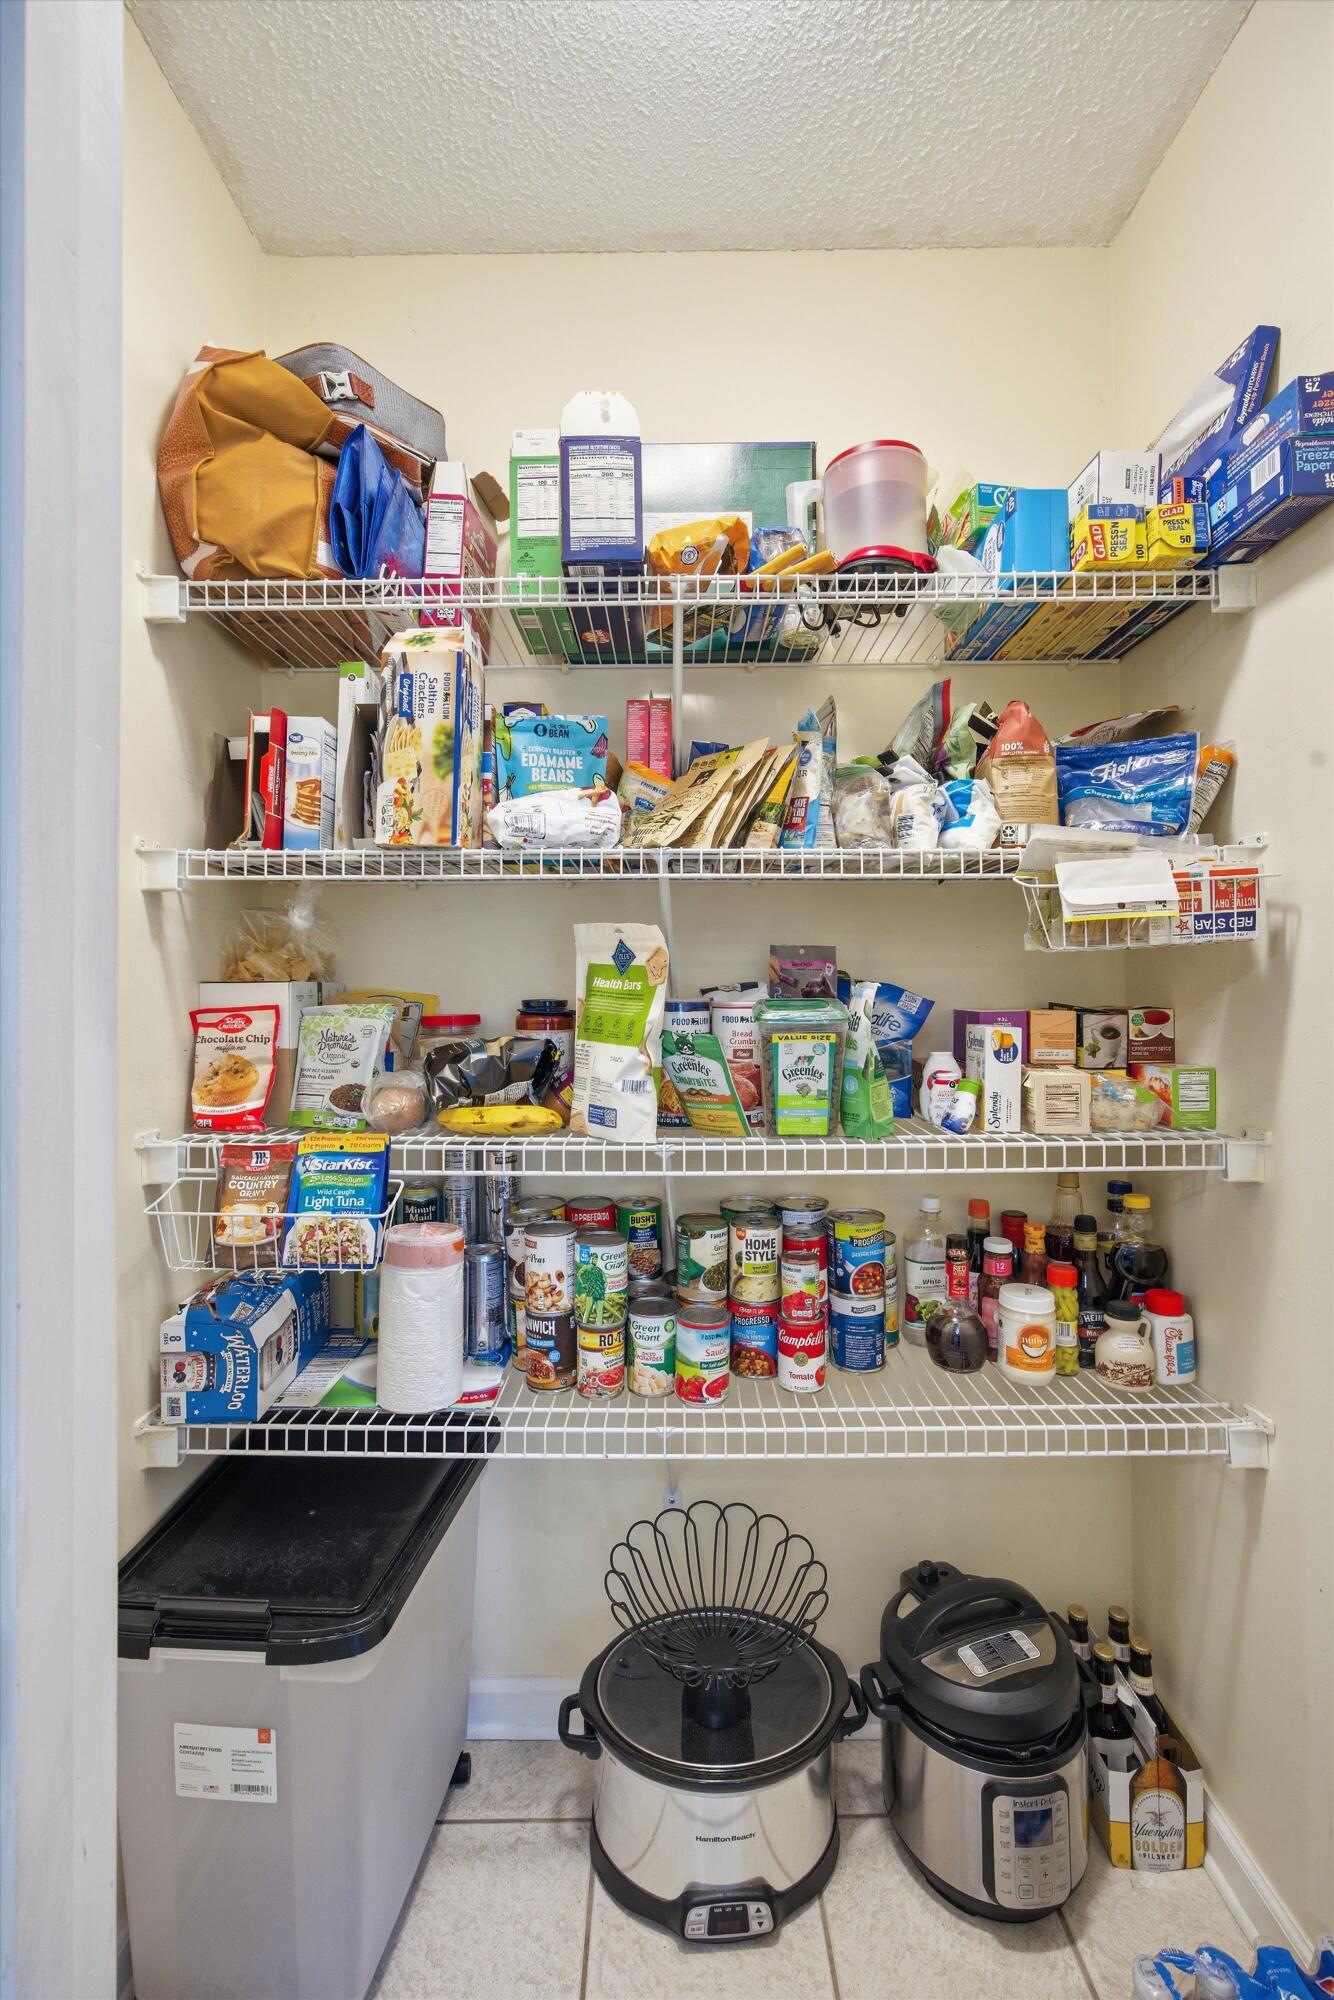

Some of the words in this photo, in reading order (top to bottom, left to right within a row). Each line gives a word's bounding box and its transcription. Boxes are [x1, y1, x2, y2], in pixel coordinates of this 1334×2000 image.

[1305, 382, 1321, 393] 75
[1295, 451, 1334, 461] Freeze
[1295, 461, 1331, 473] Paper
[1160, 506, 1184, 517] GLAD
[1168, 523, 1186, 531] SEAL
[1092, 526, 1106, 560] GLAD
[1119, 528, 1128, 551] SEAL
[1180, 535, 1191, 544] 50
[1135, 543, 1144, 560] 100
[443, 672, 452, 693] FOOD
[399, 679, 411, 713] Original
[417, 672, 428, 719] Crackers
[427, 677, 438, 714] Saltine
[442, 702, 451, 720] LION
[549, 728, 569, 738] BEAN
[1000, 742, 1023, 751] 100%
[521, 753, 583, 769] EDAMAME
[531, 768, 574, 783] BEANS
[1084, 788, 1122, 800] Chopped
[1214, 898, 1229, 909] DRY
[1194, 918, 1226, 930] STAR
[1230, 915, 1253, 927] RED
[592, 977, 623, 990] Health
[623, 978, 642, 990] Bars
[671, 1017, 691, 1026] FOOD
[722, 1015, 739, 1023] FOOD
[320, 1028, 357, 1043] Nature's
[731, 1029, 753, 1038] Bread
[245, 1034, 271, 1045] Chip
[729, 1037, 757, 1046] Crumbs
[966, 1030, 985, 1050] Splenda
[318, 1041, 359, 1056] Promise
[321, 1052, 348, 1062] Organic
[671, 1060, 712, 1078] Greenies
[782, 1067, 825, 1080] Greenies
[988, 1091, 1001, 1129] Splenda
[309, 1158, 373, 1171] StarKist
[228, 1179, 279, 1190] COUNTRY
[336, 1175, 364, 1183] Sodium
[239, 1189, 267, 1198] GRAVY
[332, 1188, 356, 1197] Caught
[304, 1196, 334, 1208] Light
[336, 1195, 365, 1207] Tuna
[404, 1204, 437, 1215] Minute
[408, 1212, 433, 1222] Maid
[630, 1214, 656, 1225] BUSH'S
[745, 1238, 777, 1250] HOME
[853, 1231, 884, 1247] PROGRESSO
[600, 1250, 627, 1262] Green
[745, 1250, 776, 1262] STYLE
[604, 1259, 627, 1271] Giant
[996, 1262, 1006, 1270] 12
[922, 1278, 942, 1286] White
[734, 1315, 770, 1326] PROGRESSO
[1083, 1313, 1105, 1322] HEIN
[631, 1320, 660, 1333] Green
[169, 1335, 182, 1343] 8
[634, 1331, 660, 1342] Giant
[778, 1329, 825, 1349] Campbell's
[636, 1354, 663, 1362] POTATOES
[705, 1347, 727, 1358] Sauce
[220, 1330, 256, 1410] WATERLOO
[788, 1371, 814, 1381] Tomato
[1012, 1798, 1040, 1809] Instant
[1133, 1820, 1184, 1841] Yuengling
[695, 1835, 731, 1843] Hamilton
[731, 1832, 755, 1842] Beach
[1135, 1840, 1183, 1854] GOLDEN
[1142, 1852, 1176, 1860] PILSNER
